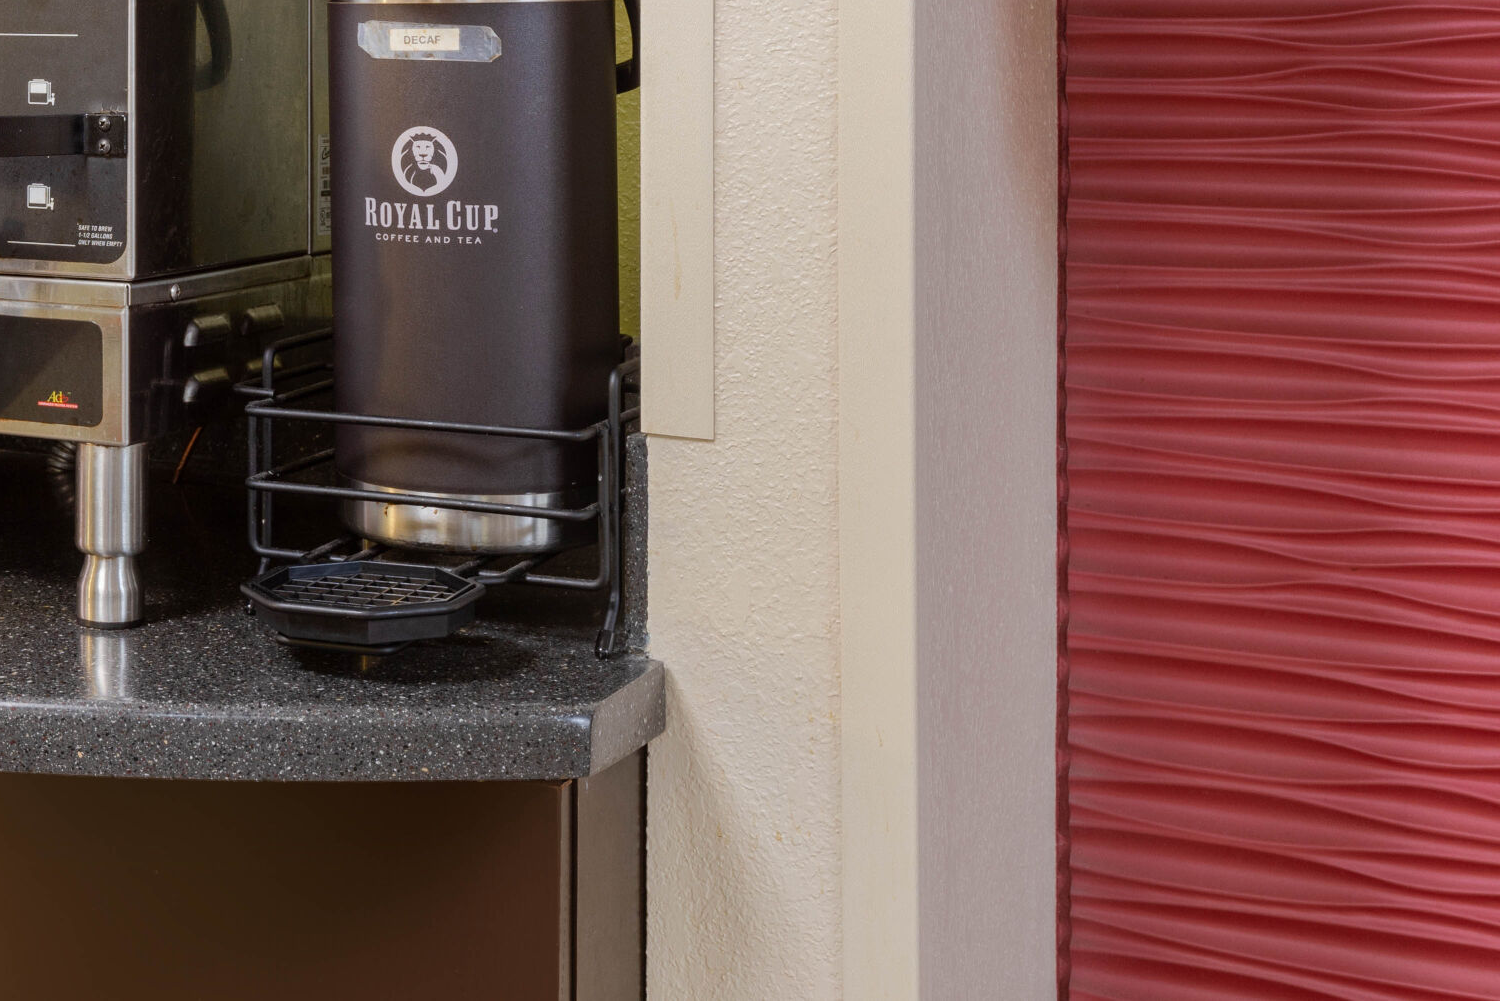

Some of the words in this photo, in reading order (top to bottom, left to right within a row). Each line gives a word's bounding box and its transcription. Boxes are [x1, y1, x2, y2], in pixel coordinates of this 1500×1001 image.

[403, 35, 441, 45] DECAF
[364, 197, 439, 230] ROYAL
[446, 200, 499, 231] CUP
[375, 233, 419, 243] COFFEE
[425, 235, 450, 244] AND
[457, 236, 482, 245] TEA
